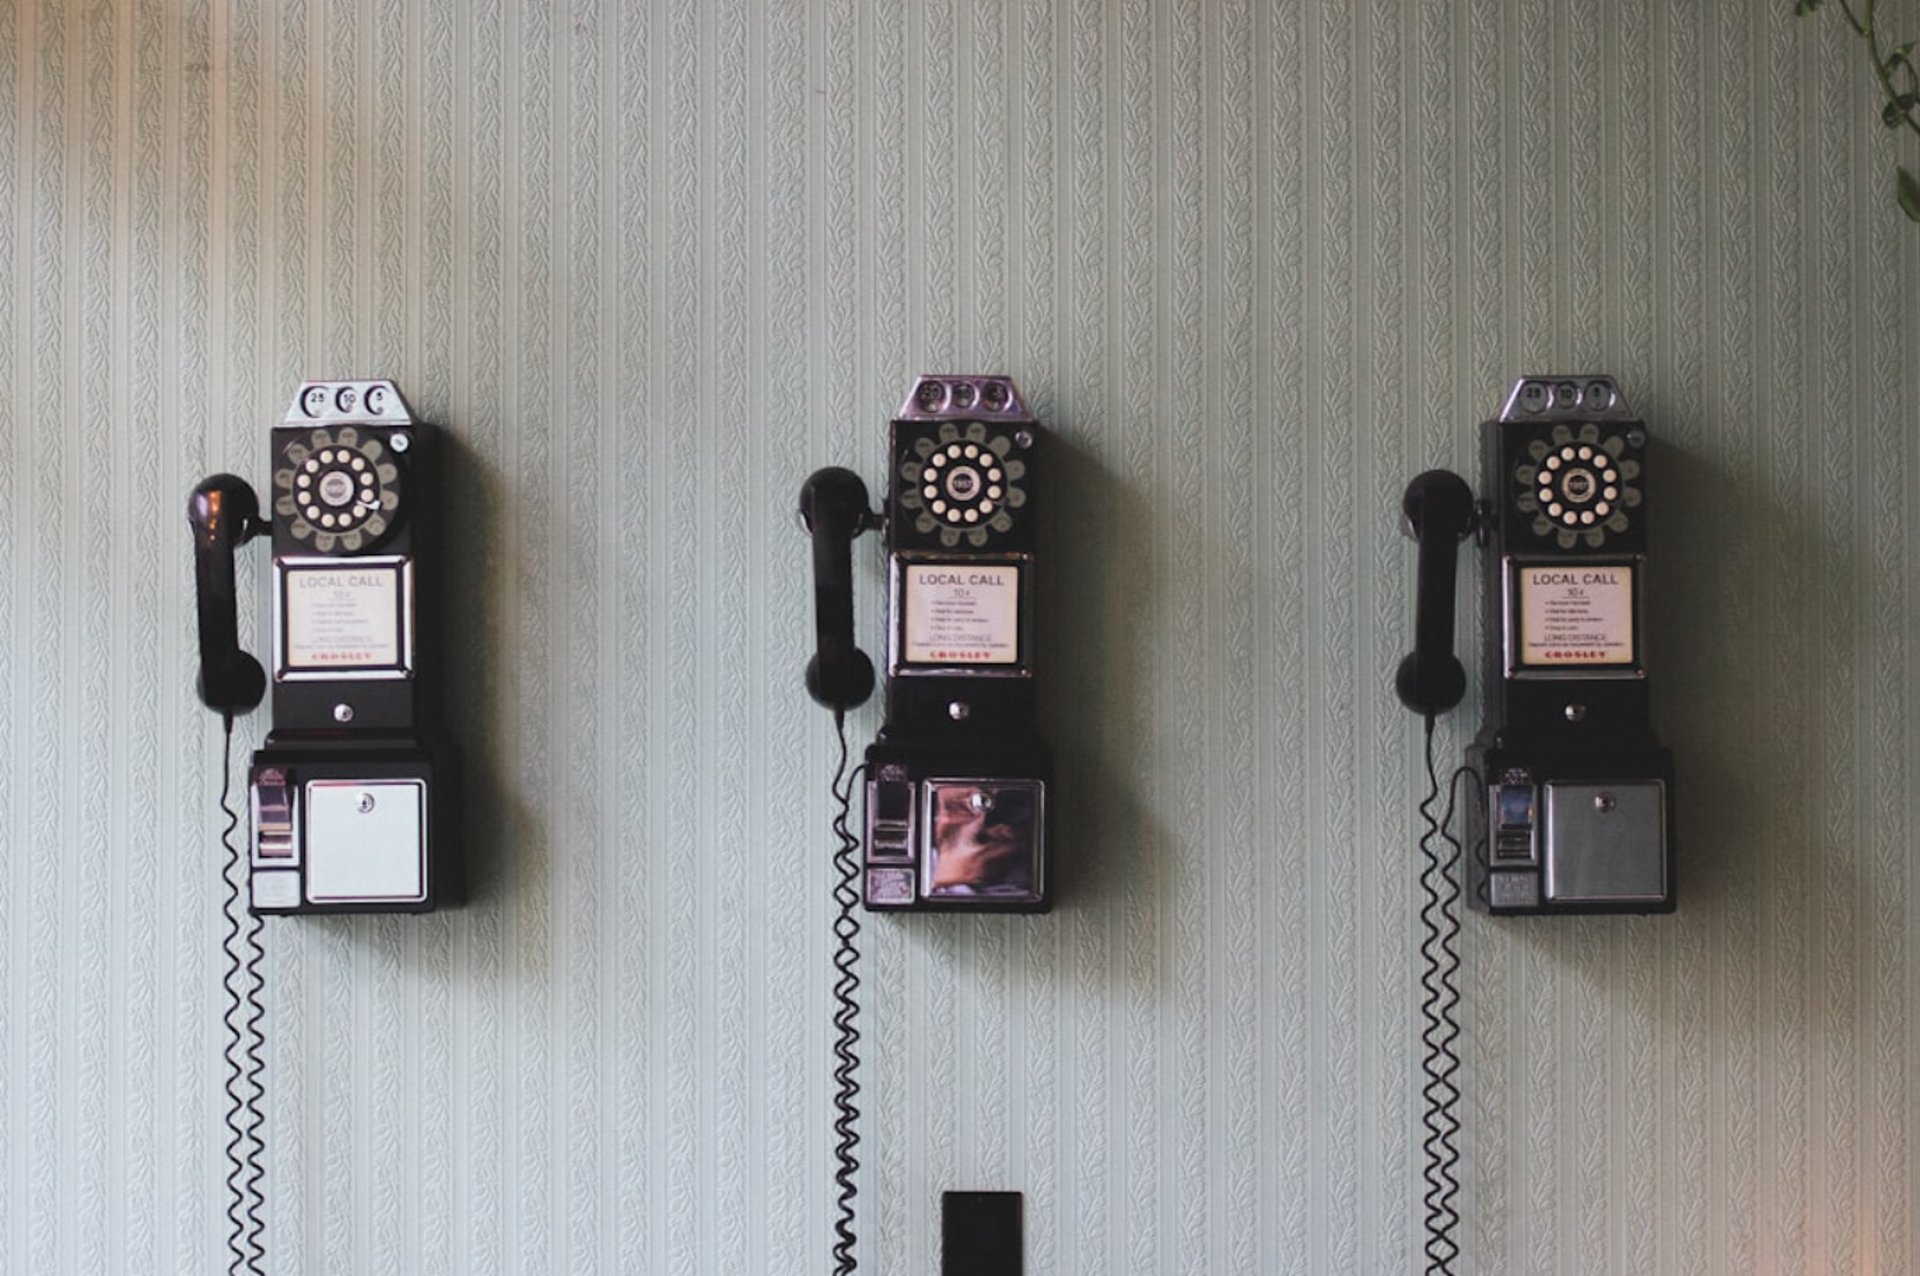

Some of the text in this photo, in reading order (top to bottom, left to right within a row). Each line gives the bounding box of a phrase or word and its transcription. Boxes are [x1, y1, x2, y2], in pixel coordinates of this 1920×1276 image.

[310, 392, 325, 403] 25
[343, 394, 356, 403] 10
[376, 392, 383, 401] 5
[1560, 389, 1573, 400] 10
[299, 575, 384, 588] LOCAL CALL
[919, 574, 1005, 586] LOCAL CALL
[1533, 573, 1618, 586] LOCAL CALL
[1544, 650, 1606, 659] CROSLEY
